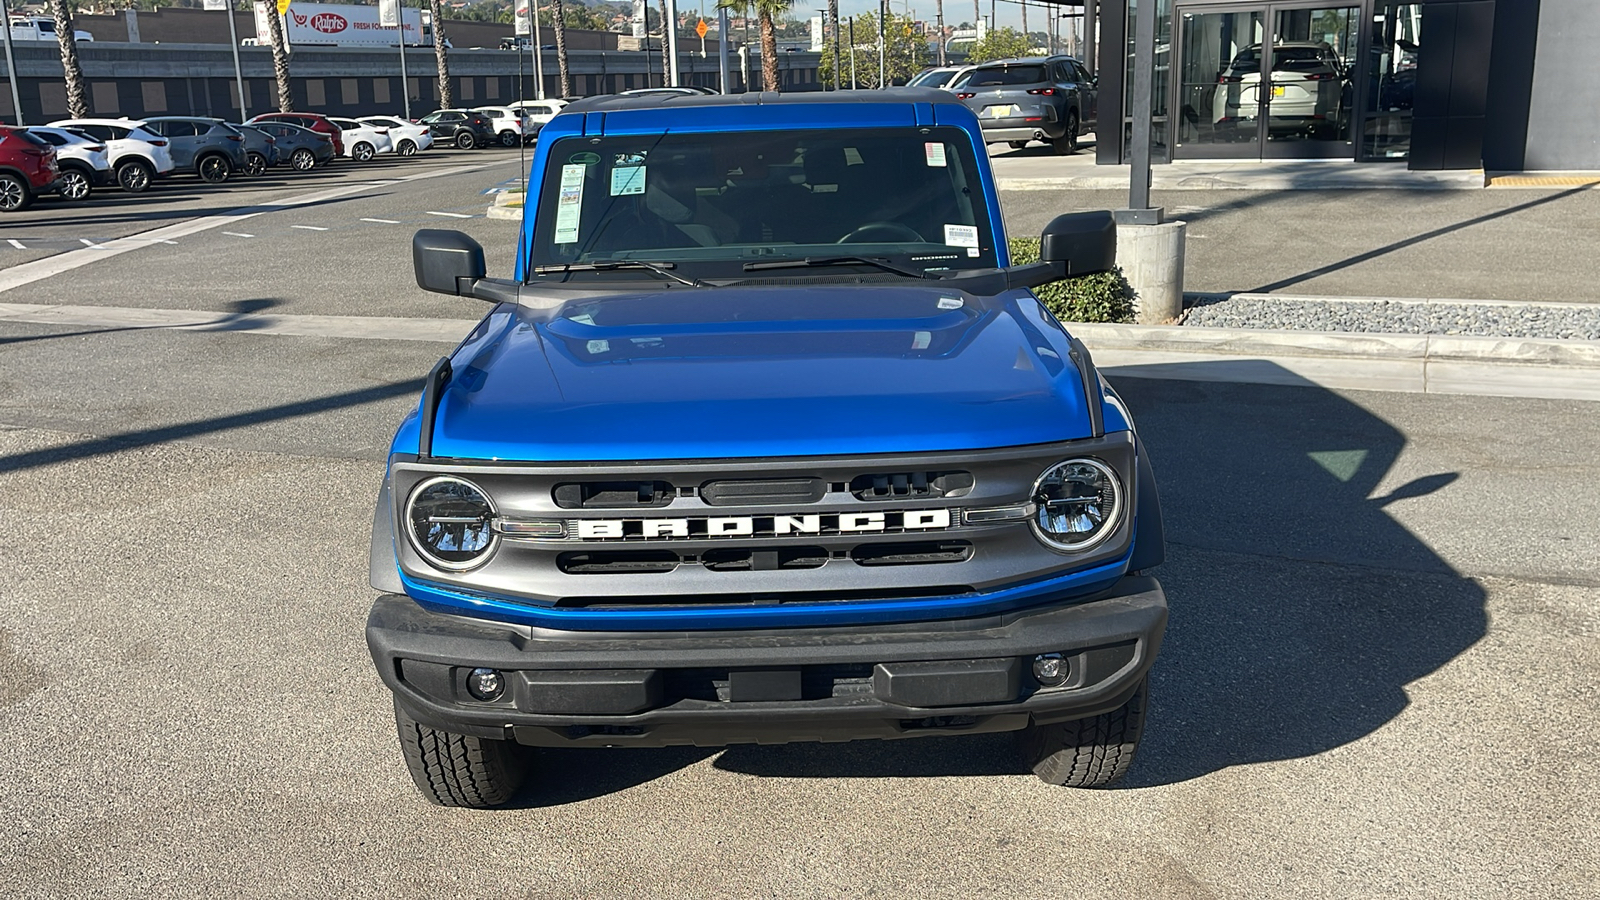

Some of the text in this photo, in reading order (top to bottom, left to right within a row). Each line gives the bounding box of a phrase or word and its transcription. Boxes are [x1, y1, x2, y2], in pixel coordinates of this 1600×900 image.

[314, 13, 345, 33] Ralphs
[353, 22, 371, 30] FRESH
[578, 510, 950, 538] BRONCO
